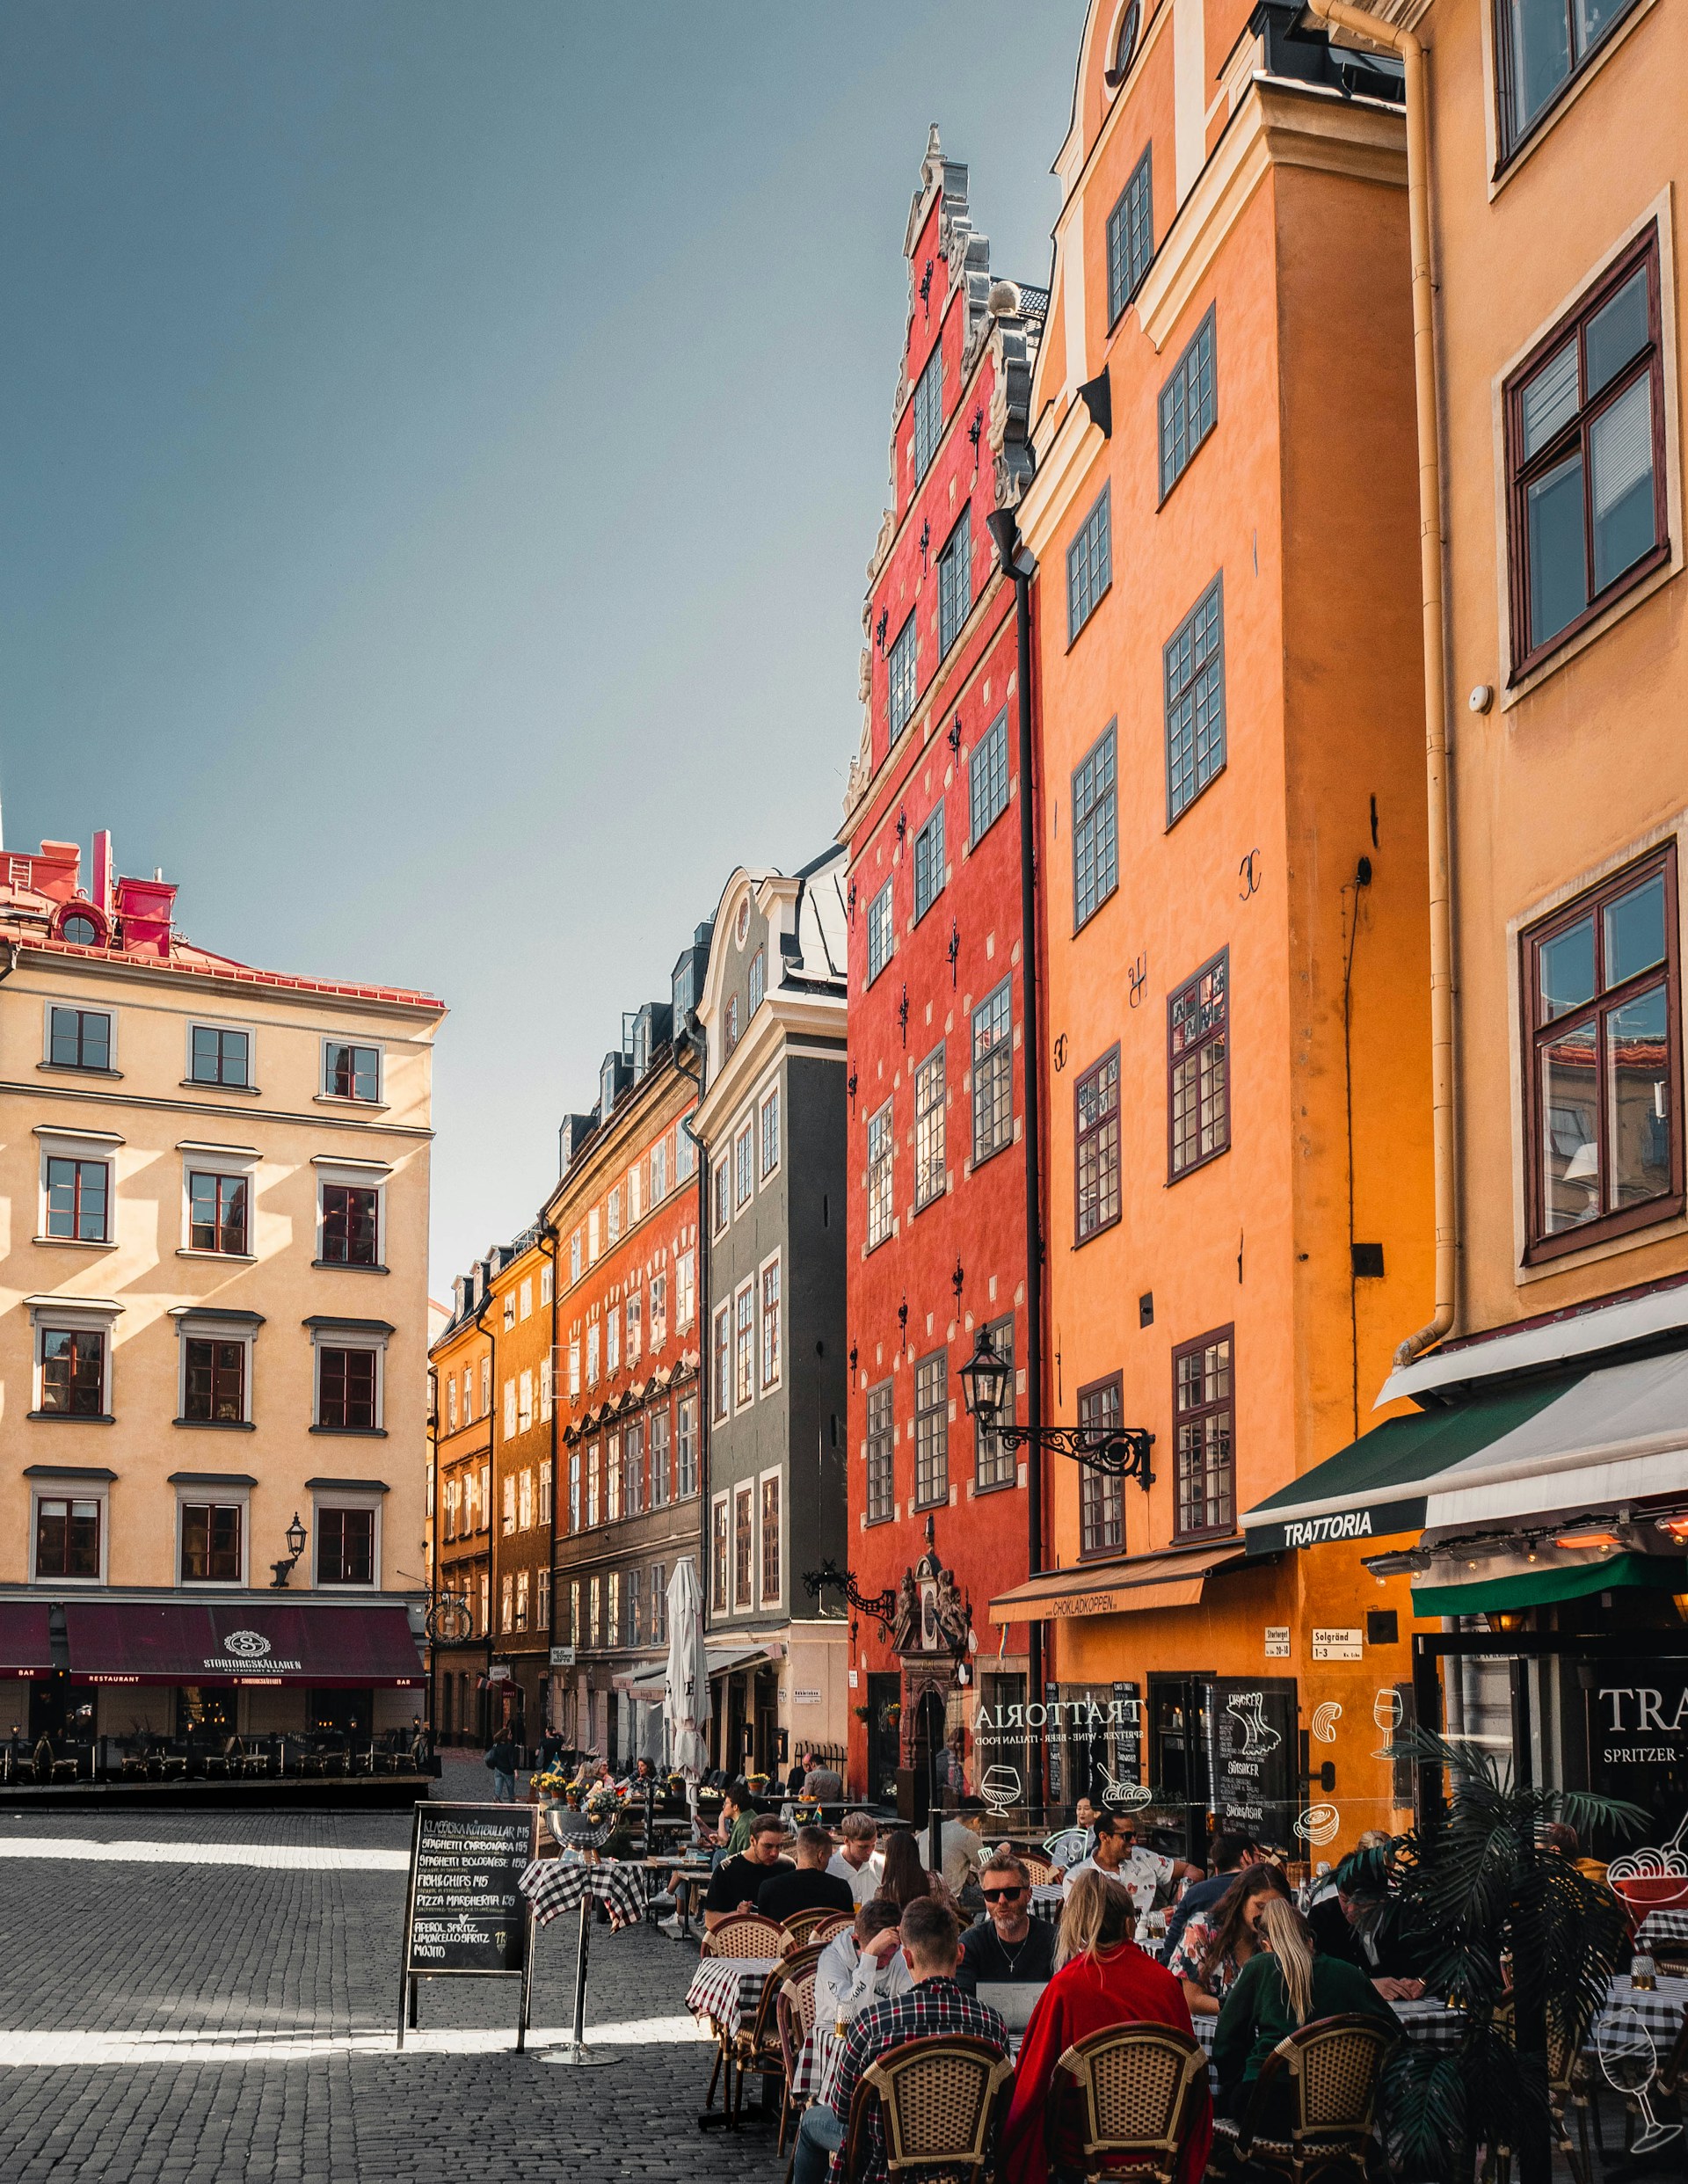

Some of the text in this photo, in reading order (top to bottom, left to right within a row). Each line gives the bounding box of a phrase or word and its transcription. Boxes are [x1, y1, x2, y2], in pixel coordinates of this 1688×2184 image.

[1284, 1511, 1372, 1547] TRATTORIA
[1315, 1632, 1349, 1643] Solgränd
[1315, 1649, 1328, 1657] 1-3
[203, 1658, 302, 1670] STORTORGSKÄLLAREN
[1604, 1747, 1677, 1763] SPRITZER
[1227, 1760, 1259, 1777] SÖTSAKER
[1226, 1803, 1263, 1821] SMÖRGÅSAR
[422, 1838, 462, 1851] SPAGHETTI
[463, 1841, 514, 1853] CARBONARA
[515, 1841, 528, 1853] 155
[418, 1854, 528, 1869] SPAGHETTI BOLOGNESE 155
[472, 1875, 489, 1888] 145
[416, 1894, 444, 1907] PIZZA
[446, 1894, 499, 1907] MARGHERITA
[414, 1922, 478, 1933] APEROL SPRITZ
[413, 1933, 461, 1944] LIMONCELLO
[461, 1933, 490, 1944] SPRITZ
[413, 1944, 446, 1959] MOJITO
